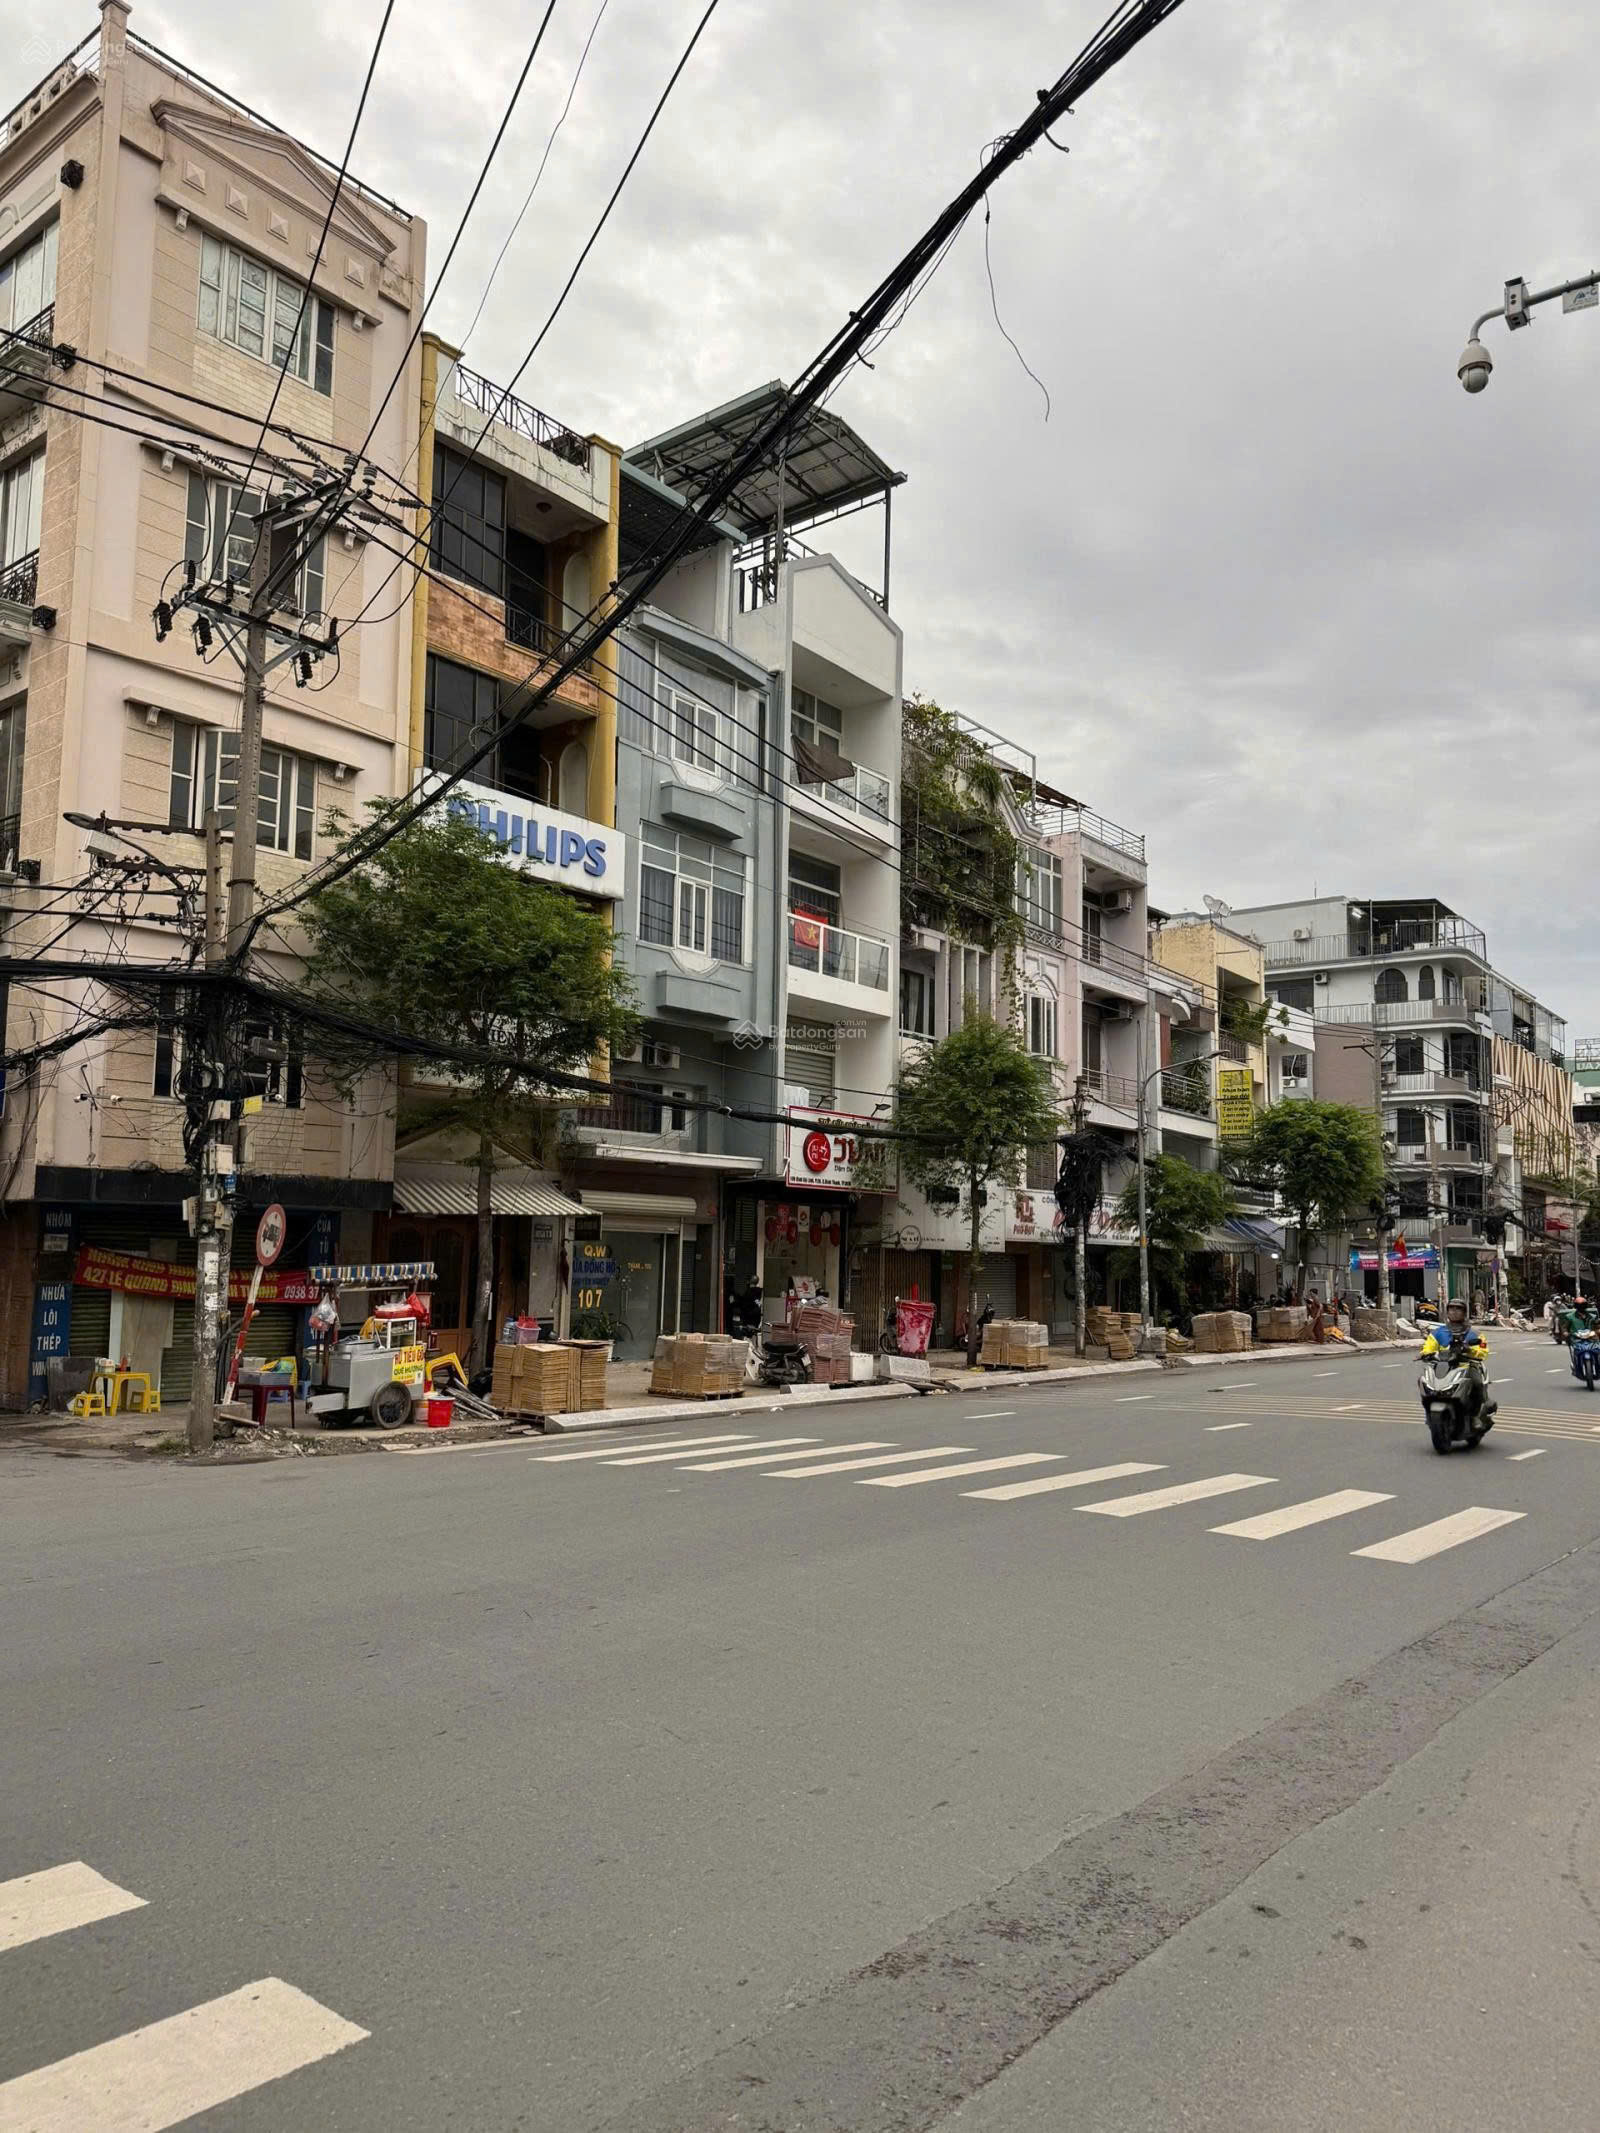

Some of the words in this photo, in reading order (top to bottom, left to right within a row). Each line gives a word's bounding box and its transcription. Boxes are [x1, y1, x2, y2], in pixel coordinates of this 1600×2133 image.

[449, 801, 607, 877] PHILIPS
[82, 1266, 106, 1284] 427
[124, 1274, 169, 1292] QUANG
[284, 1285, 306, 1299] 0938
[579, 1289, 603, 1308] 107
[37, 1333, 61, 1351] THÉP
